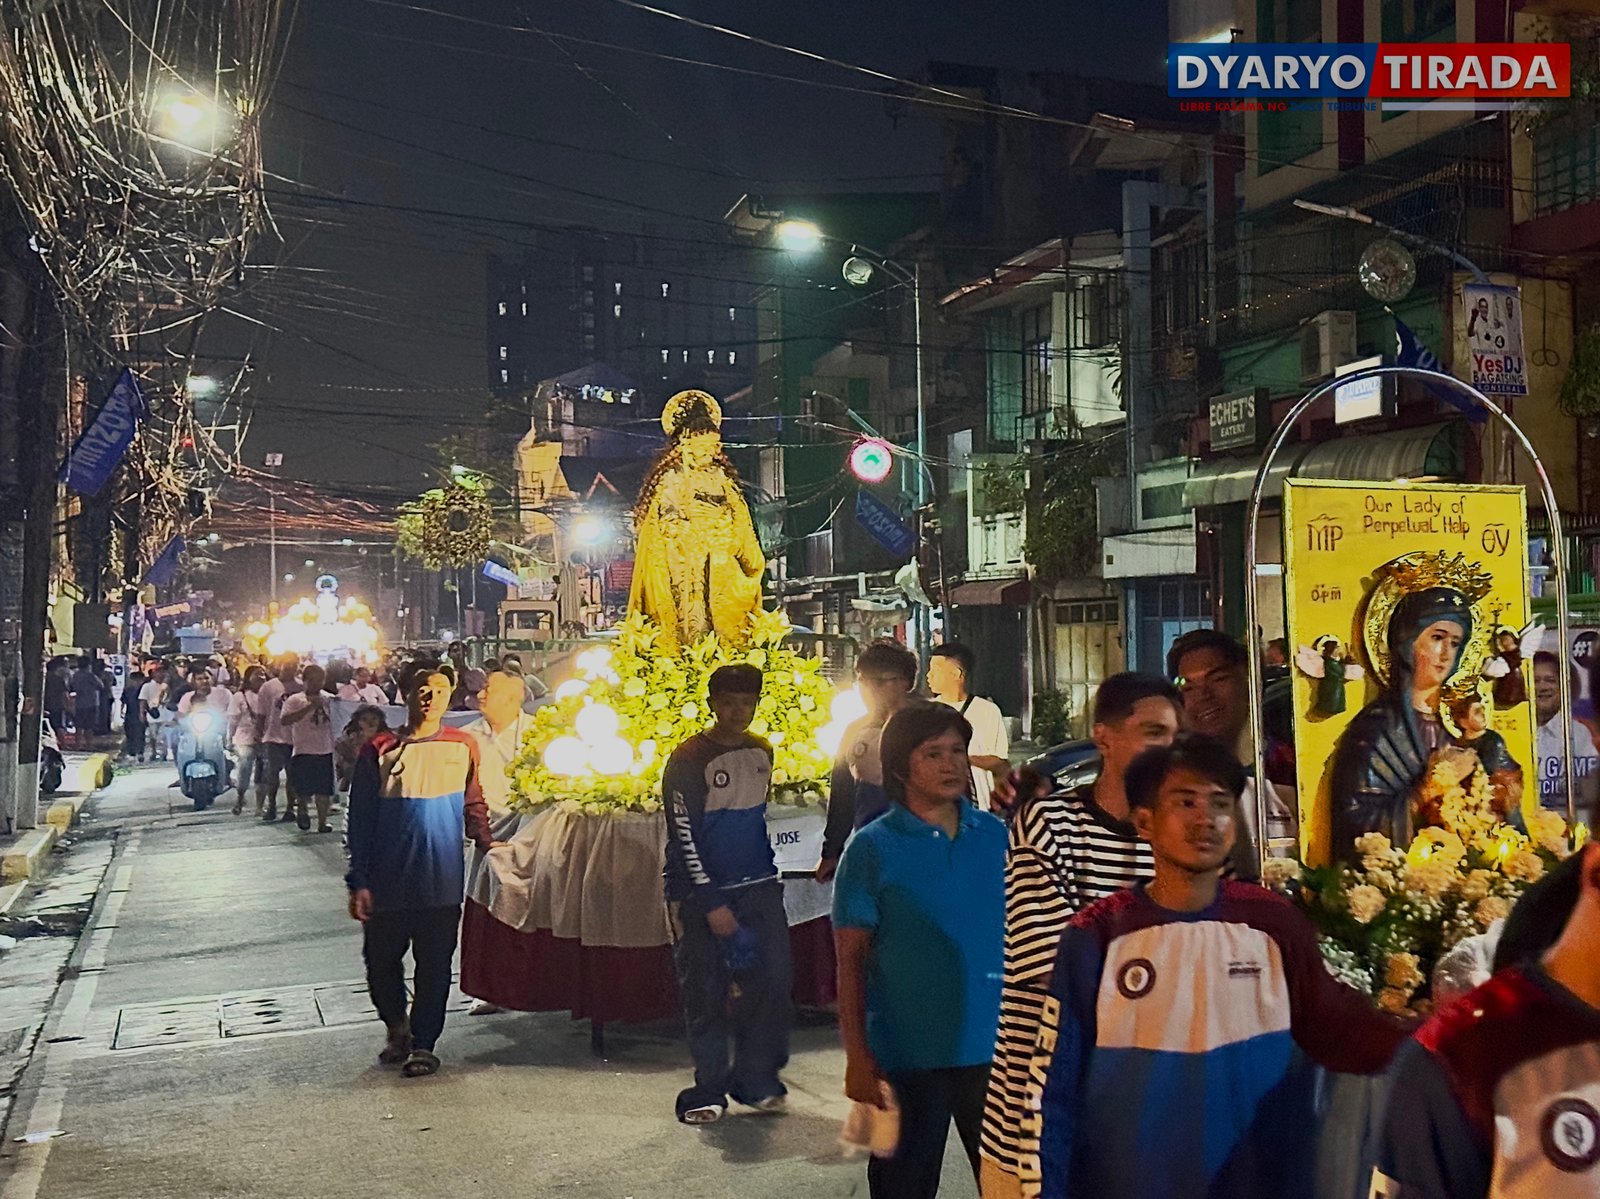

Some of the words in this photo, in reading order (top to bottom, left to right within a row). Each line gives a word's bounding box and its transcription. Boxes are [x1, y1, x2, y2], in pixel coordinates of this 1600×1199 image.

[1210, 394, 1255, 427] ECHET'S
[1220, 422, 1246, 438] EATERY
[1364, 495, 1393, 513] Our
[1403, 495, 1442, 517] Lady
[1451, 495, 1467, 514] of
[775, 831, 801, 846] JOSE
